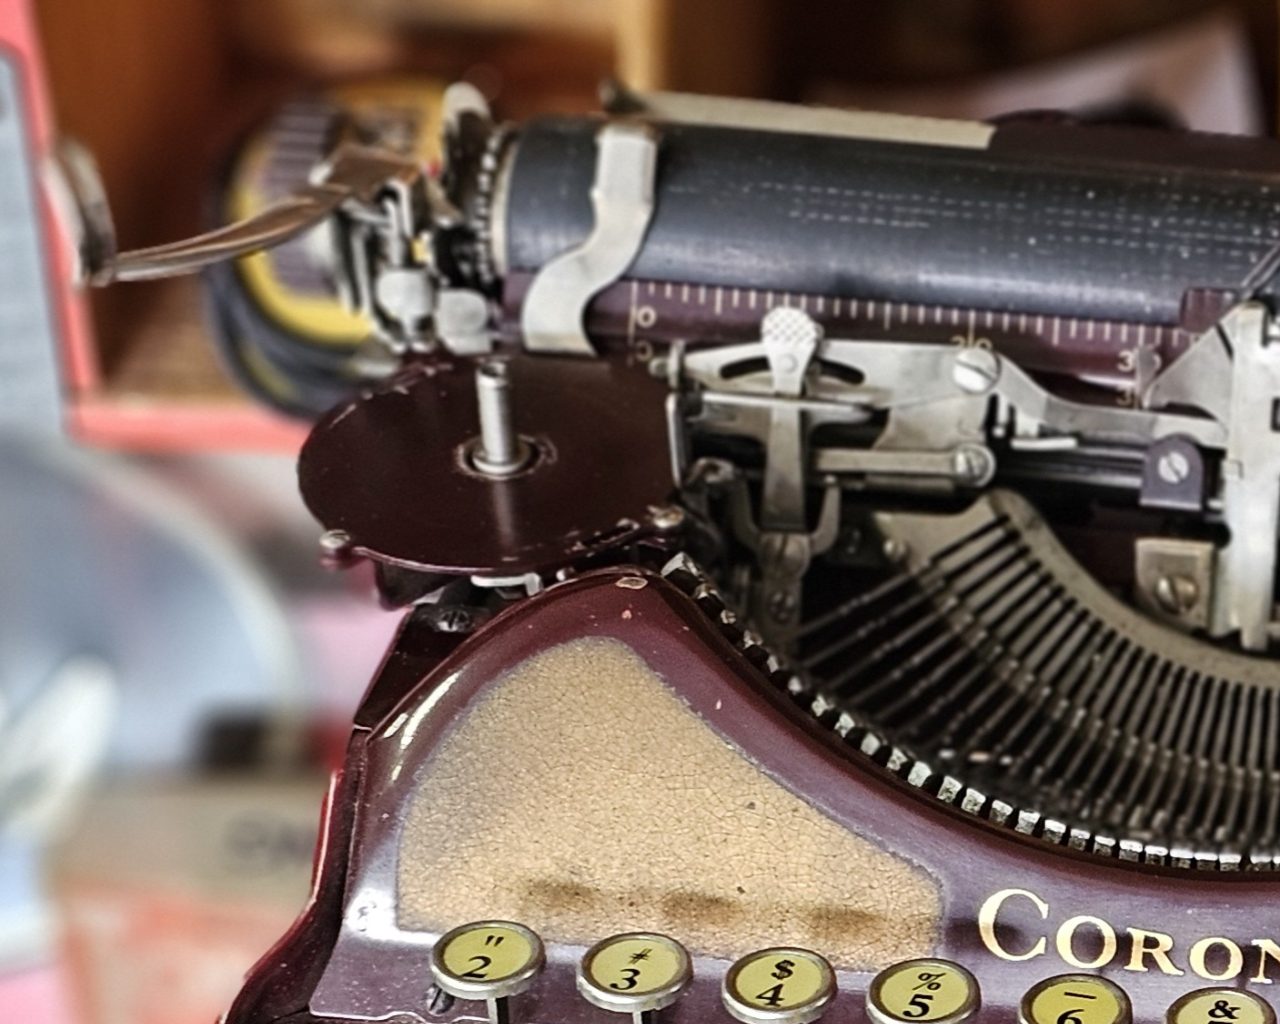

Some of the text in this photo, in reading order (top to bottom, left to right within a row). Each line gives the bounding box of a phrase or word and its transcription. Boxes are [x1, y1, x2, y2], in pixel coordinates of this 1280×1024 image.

[463, 955, 492, 978] 2
[770, 959, 796, 981] $
[609, 968, 641, 991] 3
[912, 972, 946, 991] %
[755, 983, 785, 1007] 4
[902, 993, 935, 1018] 5
[1207, 999, 1241, 1020] &
